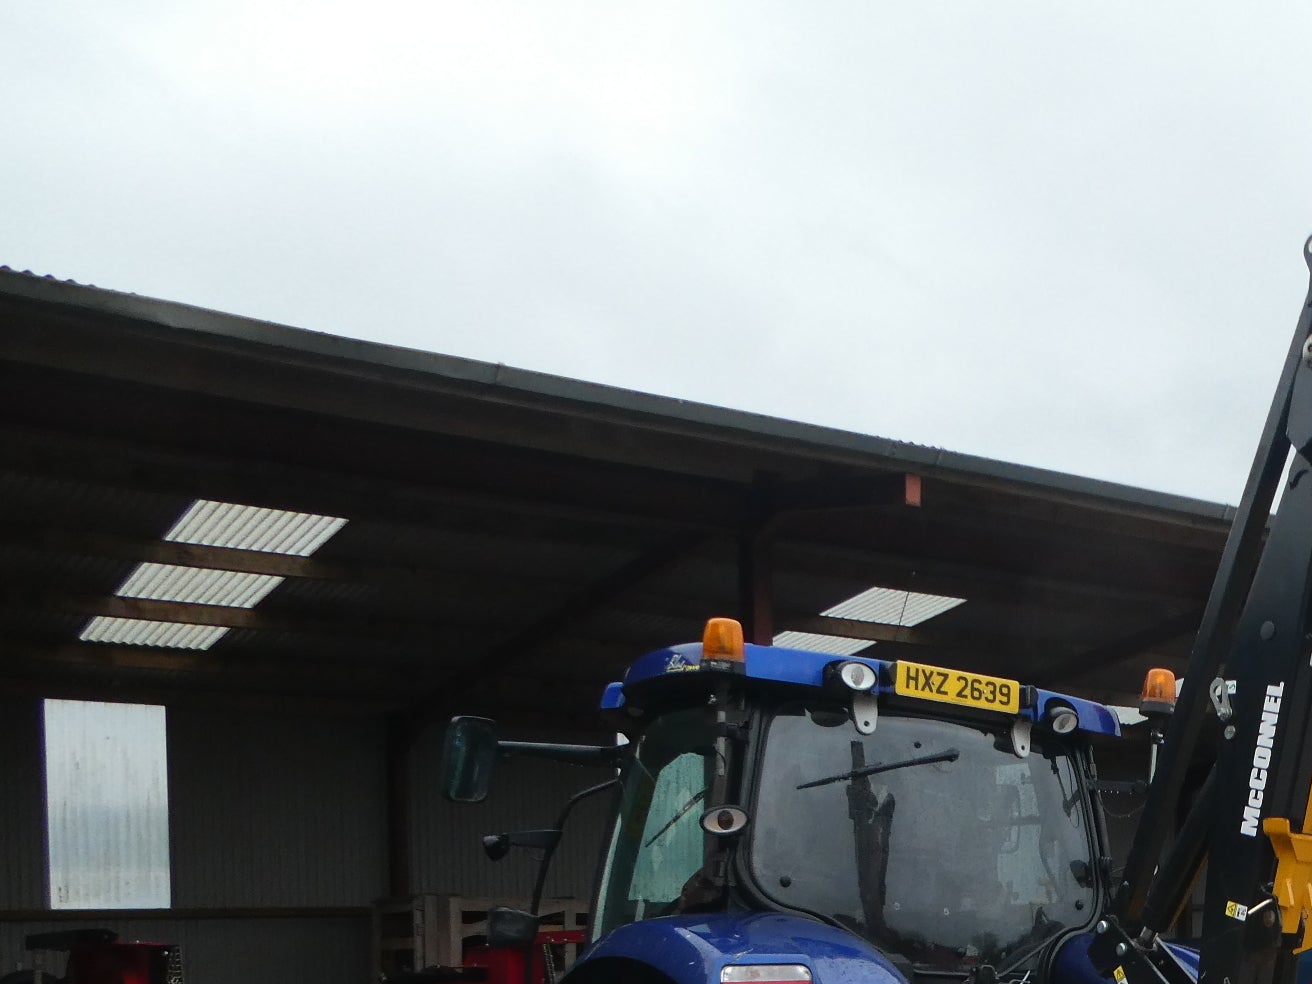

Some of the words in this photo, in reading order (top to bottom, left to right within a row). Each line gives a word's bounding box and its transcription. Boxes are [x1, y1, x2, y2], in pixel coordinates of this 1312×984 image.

[905, 666, 949, 696] HXZ
[955, 675, 1012, 706] 2639
[1240, 681, 1285, 837] McCONNEL
